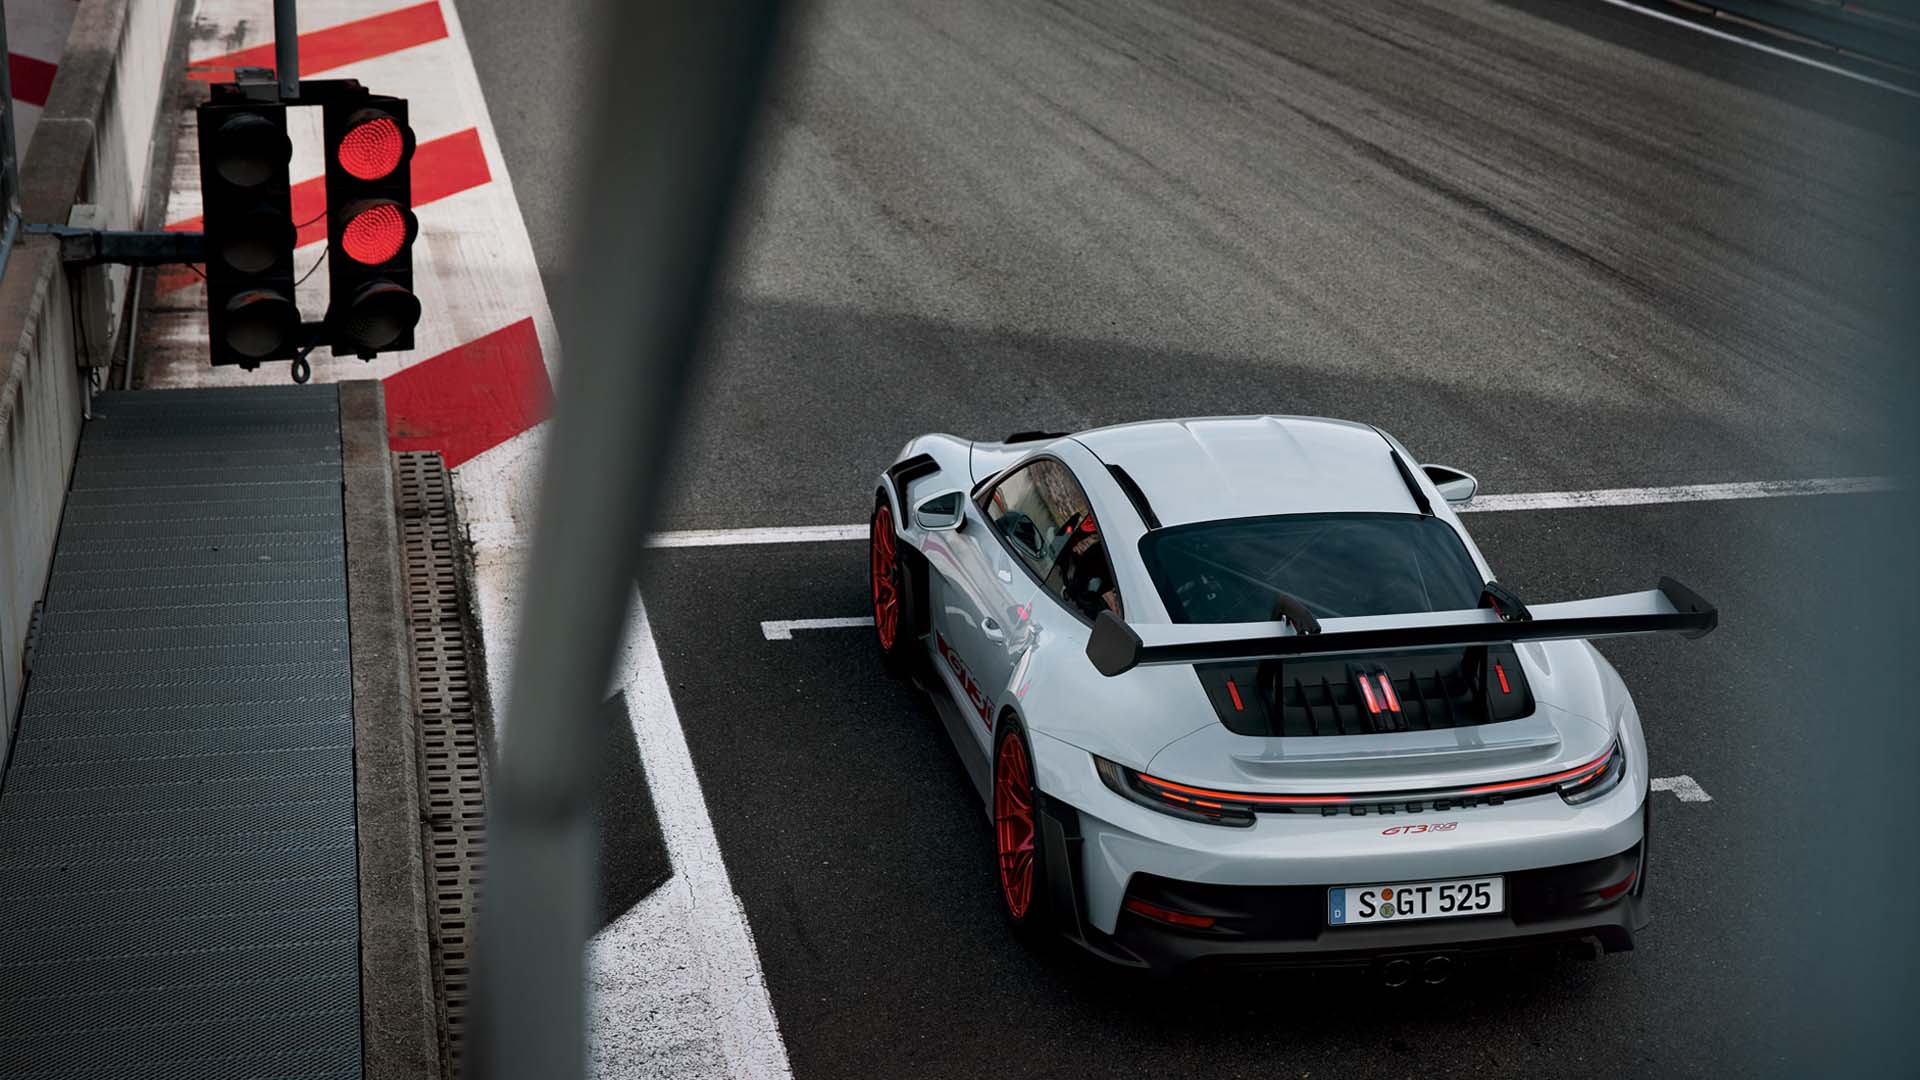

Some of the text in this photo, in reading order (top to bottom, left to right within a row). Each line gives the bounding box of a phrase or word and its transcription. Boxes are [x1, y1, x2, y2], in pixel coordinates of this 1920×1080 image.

[1358, 882, 1491, 918] S GT 525
